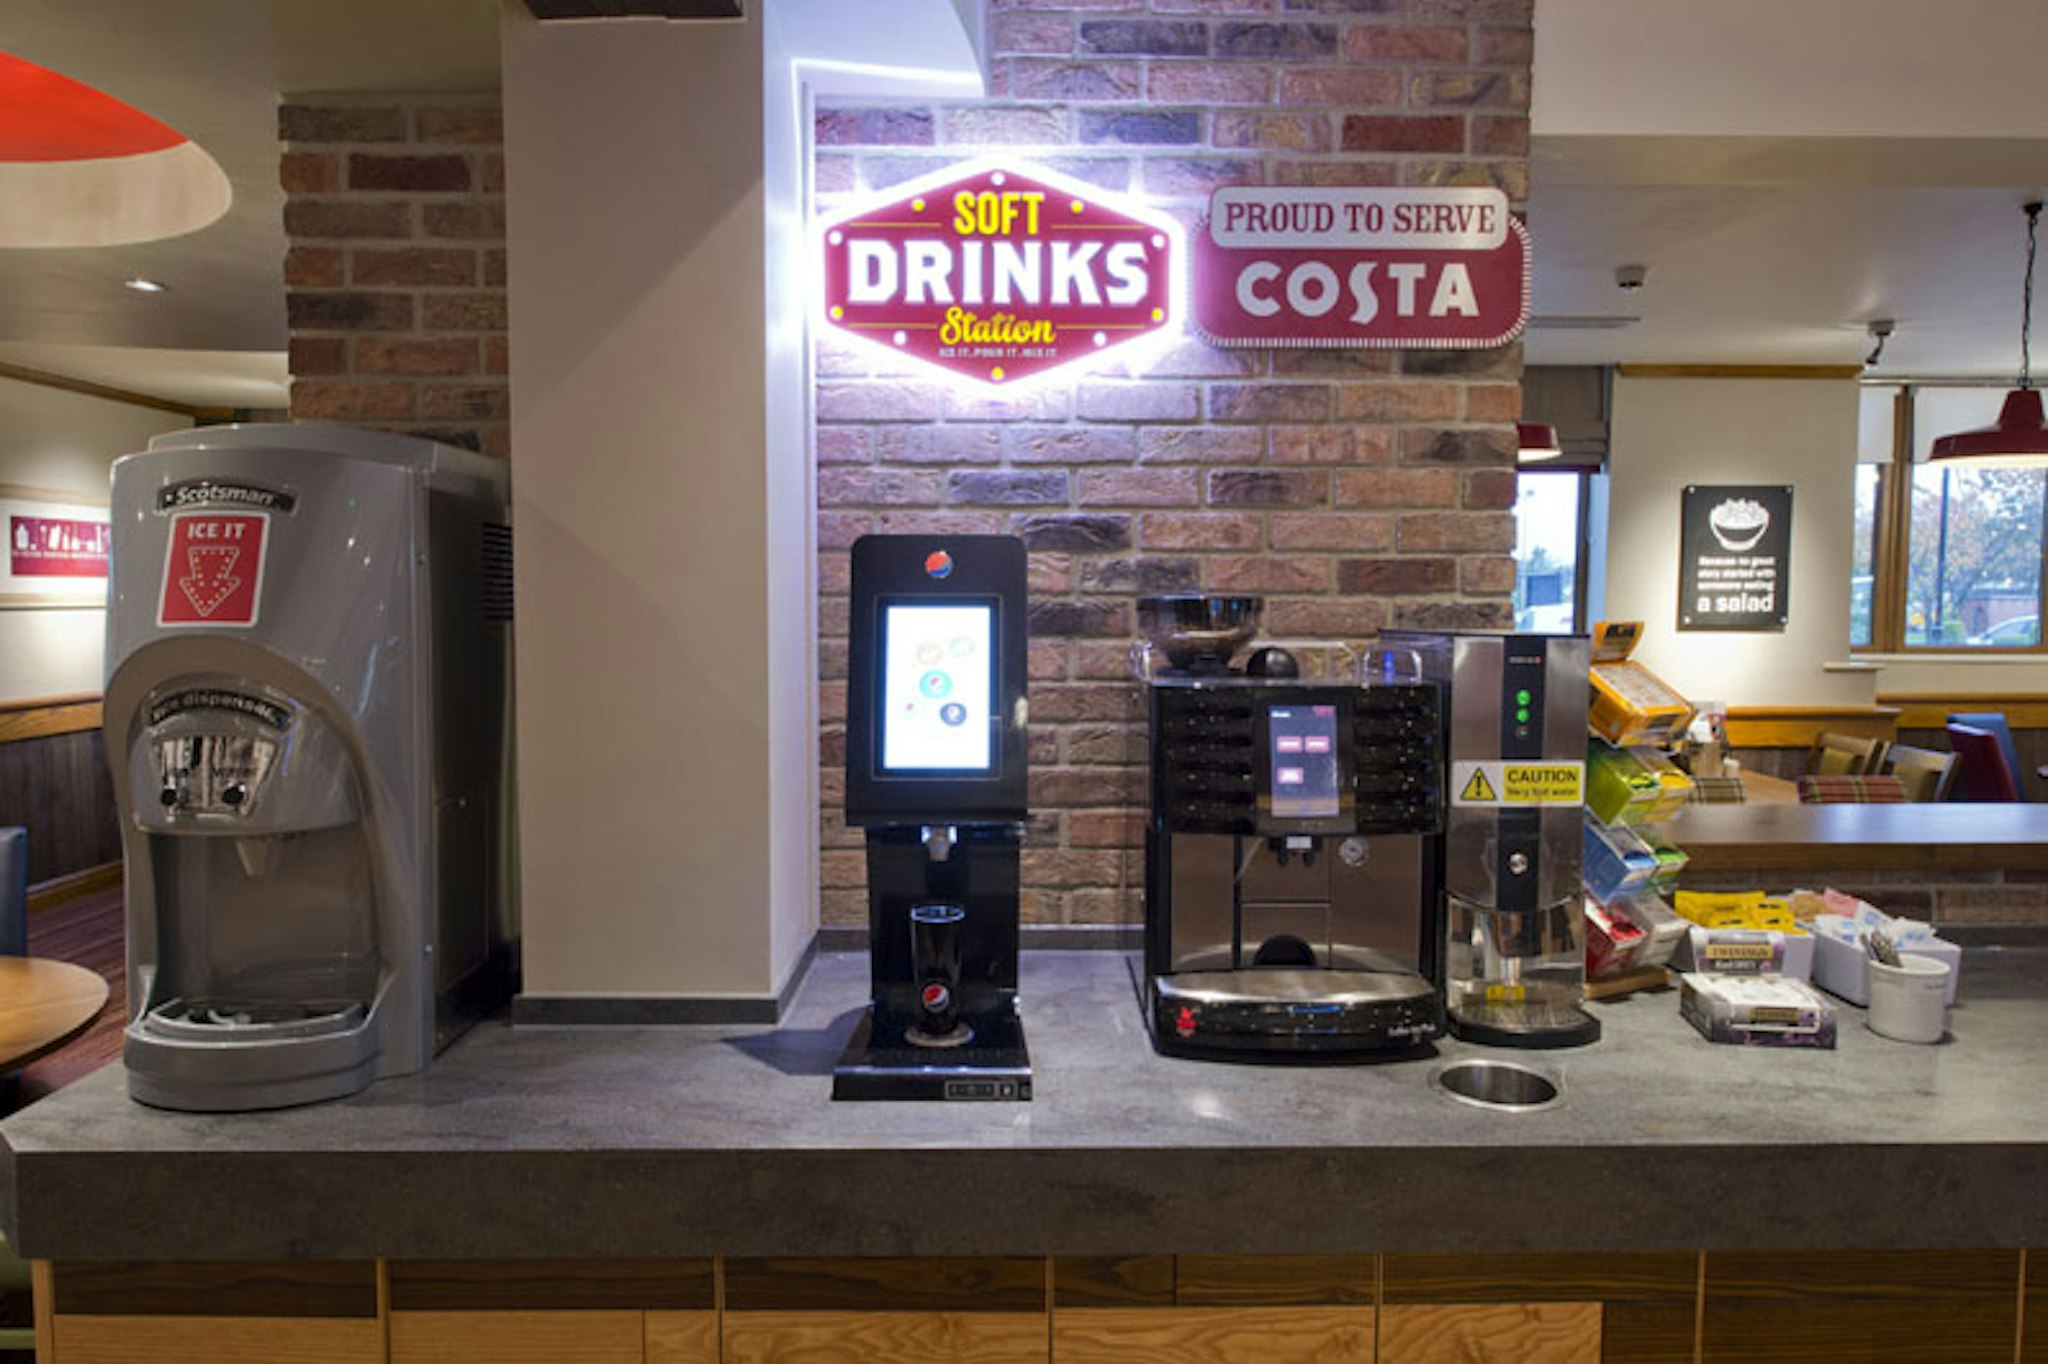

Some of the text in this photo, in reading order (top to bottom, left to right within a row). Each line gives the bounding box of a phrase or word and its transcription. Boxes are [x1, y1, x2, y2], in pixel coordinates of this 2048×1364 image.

[954, 191, 1045, 235] SOFT
[1224, 203, 1495, 234] PROUD TO SERVE
[847, 239, 1149, 306] DRINKS
[1235, 261, 1480, 325] COSTA
[940, 306, 1056, 345] Station
[176, 486, 274, 505] Scotsman
[187, 523, 246, 539] ICE IT
[1697, 592, 1775, 612] a salad
[1508, 769, 1577, 784] CAUTION
